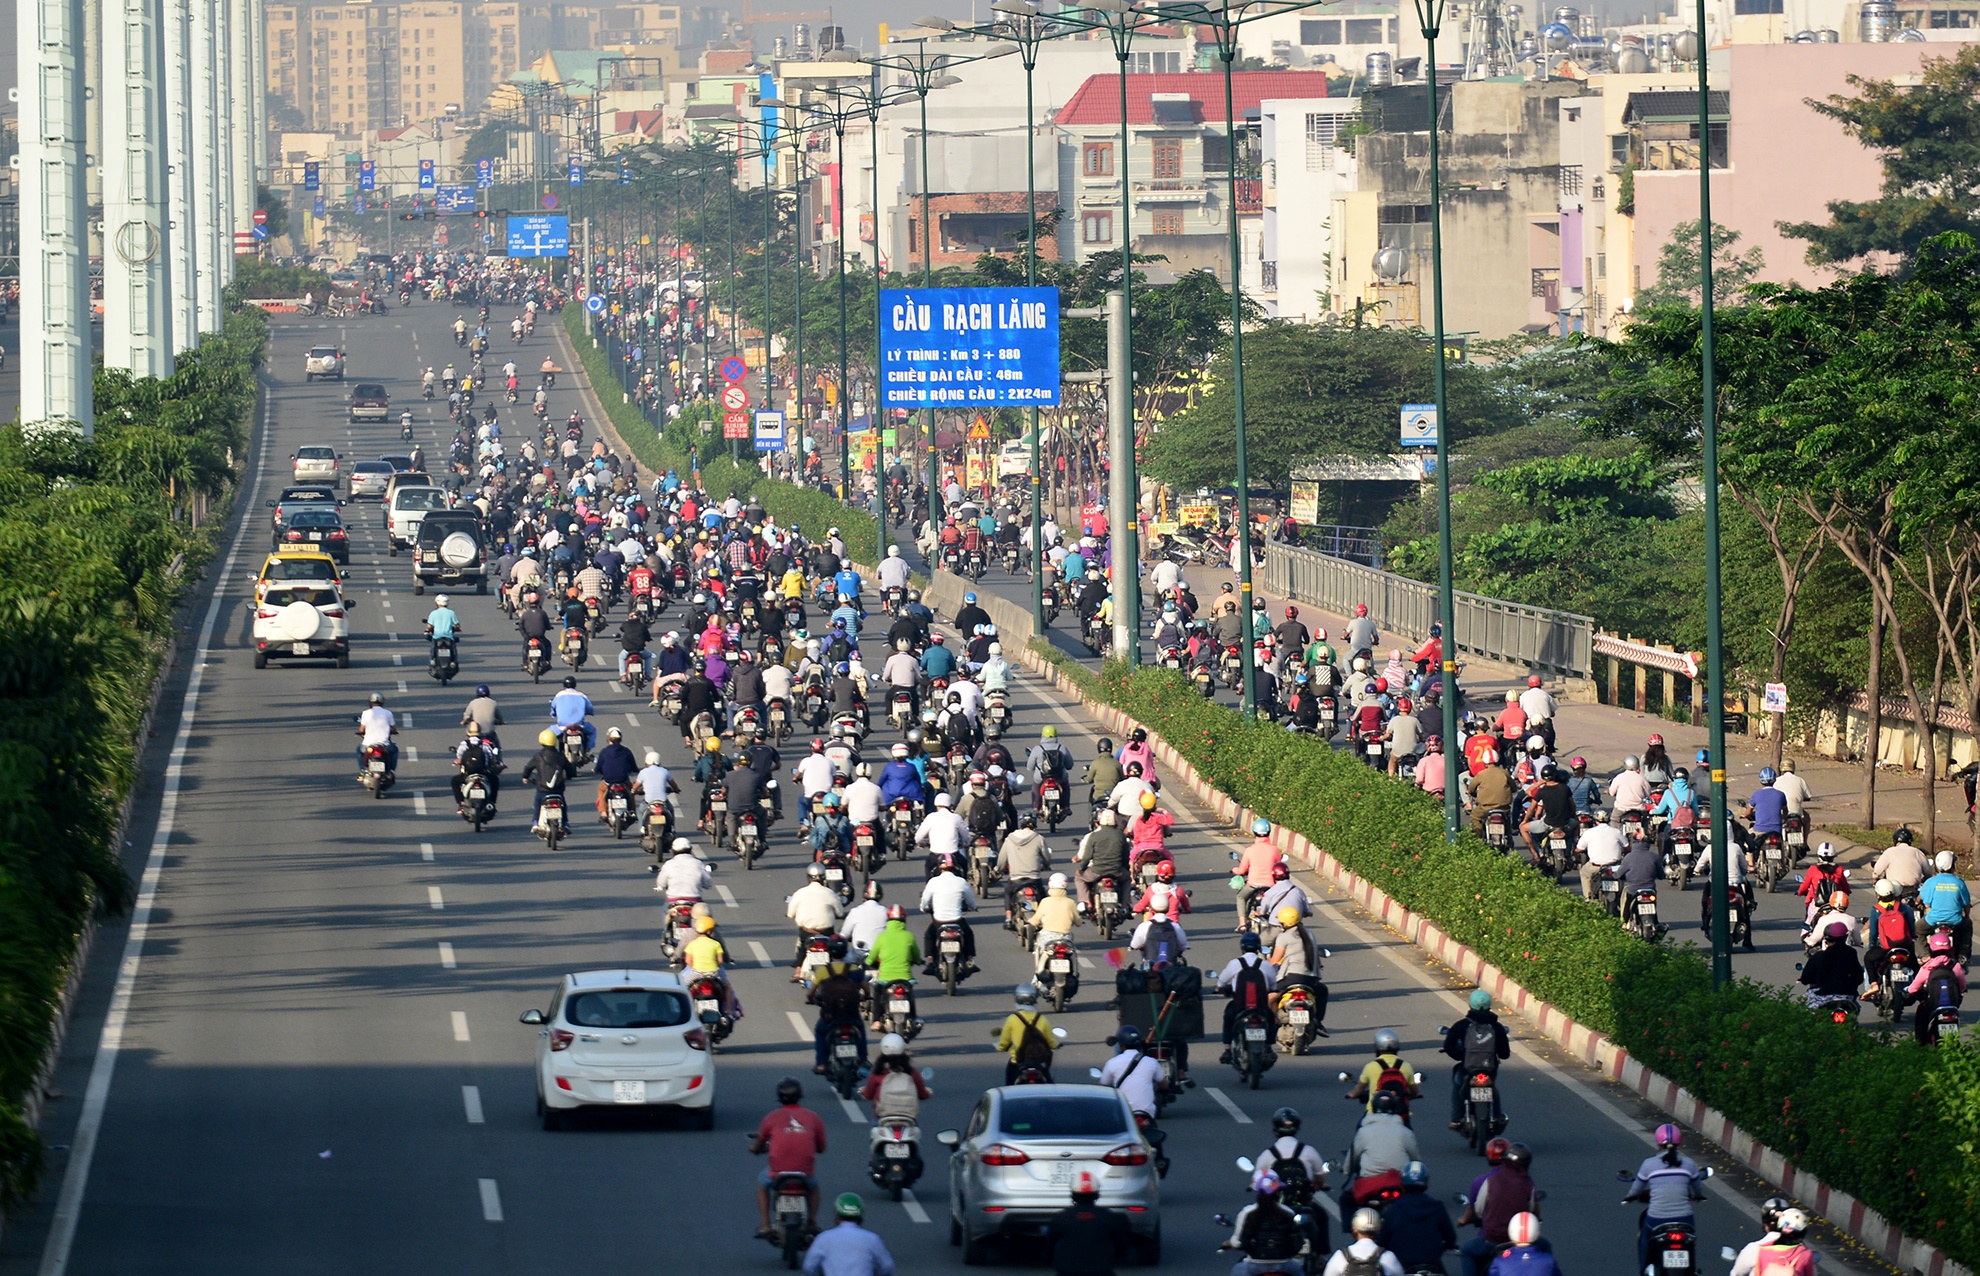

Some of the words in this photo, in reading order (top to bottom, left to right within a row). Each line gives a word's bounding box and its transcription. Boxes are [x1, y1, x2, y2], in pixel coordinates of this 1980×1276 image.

[892, 294, 930, 332] CẦU
[943, 303, 992, 336] RẠCH
[998, 298, 1046, 330] LĂNG
[888, 348, 901, 362] LÝ
[906, 348, 939, 361] TRÌNH
[950, 350, 967, 360] Km
[972, 349, 979, 360] 3
[998, 348, 1020, 360] 880
[888, 366, 926, 382] CHIỀU
[930, 369, 952, 382] DÀI
[956, 366, 983, 381] CẦU
[888, 386, 926, 401] CHIỀU
[930, 388, 964, 402] RỘNG
[969, 385, 995, 400] CẦU
[1008, 388, 1052, 400] 2X24m
[636, 576, 649, 588] 88
